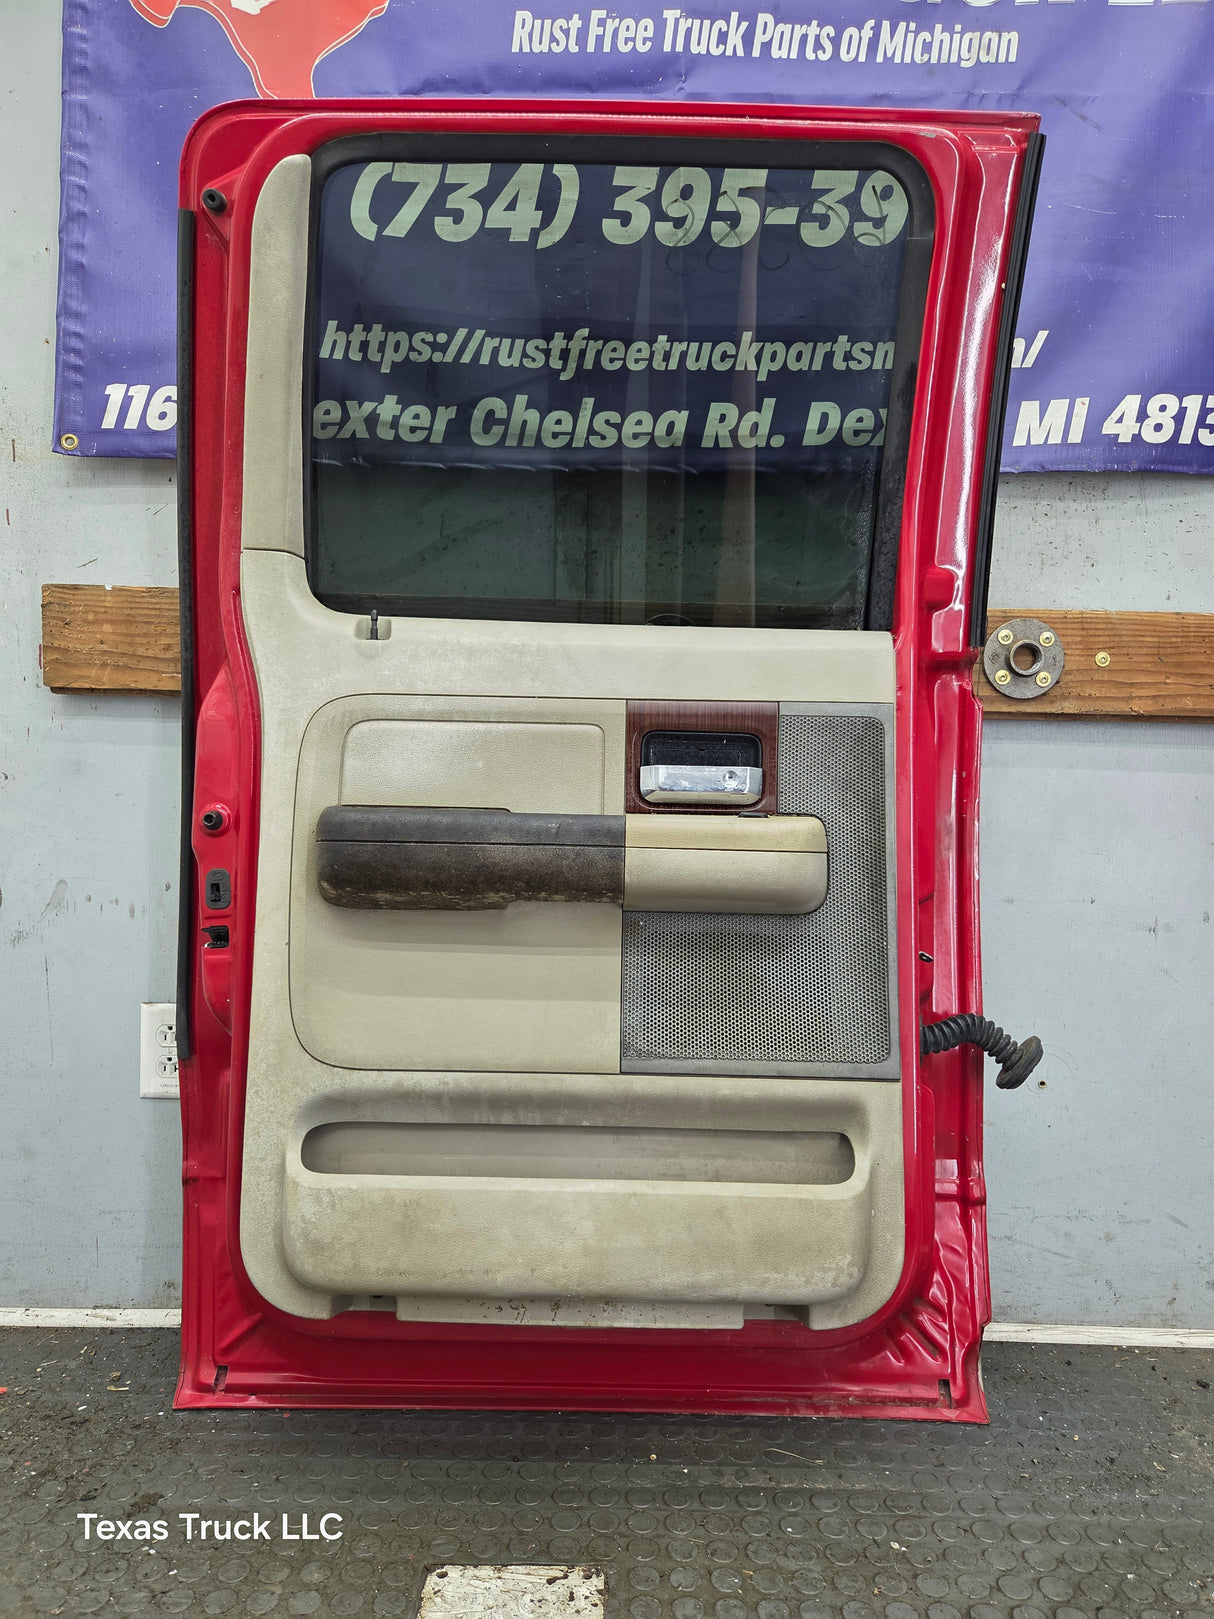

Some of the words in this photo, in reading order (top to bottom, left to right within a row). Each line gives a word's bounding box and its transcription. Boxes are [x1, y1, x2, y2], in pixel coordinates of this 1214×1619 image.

[512, 10, 582, 53] Rust
[587, 10, 654, 53] Free
[663, 10, 749, 57] Truck
[752, 13, 835, 61] Parts
[840, 19, 875, 62] of
[876, 20, 1019, 68] Michigan
[351, 162, 579, 250] (734)
[101, 383, 178, 431] 116
[313, 394, 457, 444] exter
[470, 395, 689, 448] Chelsea
[701, 398, 786, 448] Rd.
[1013, 397, 1090, 446] MI
